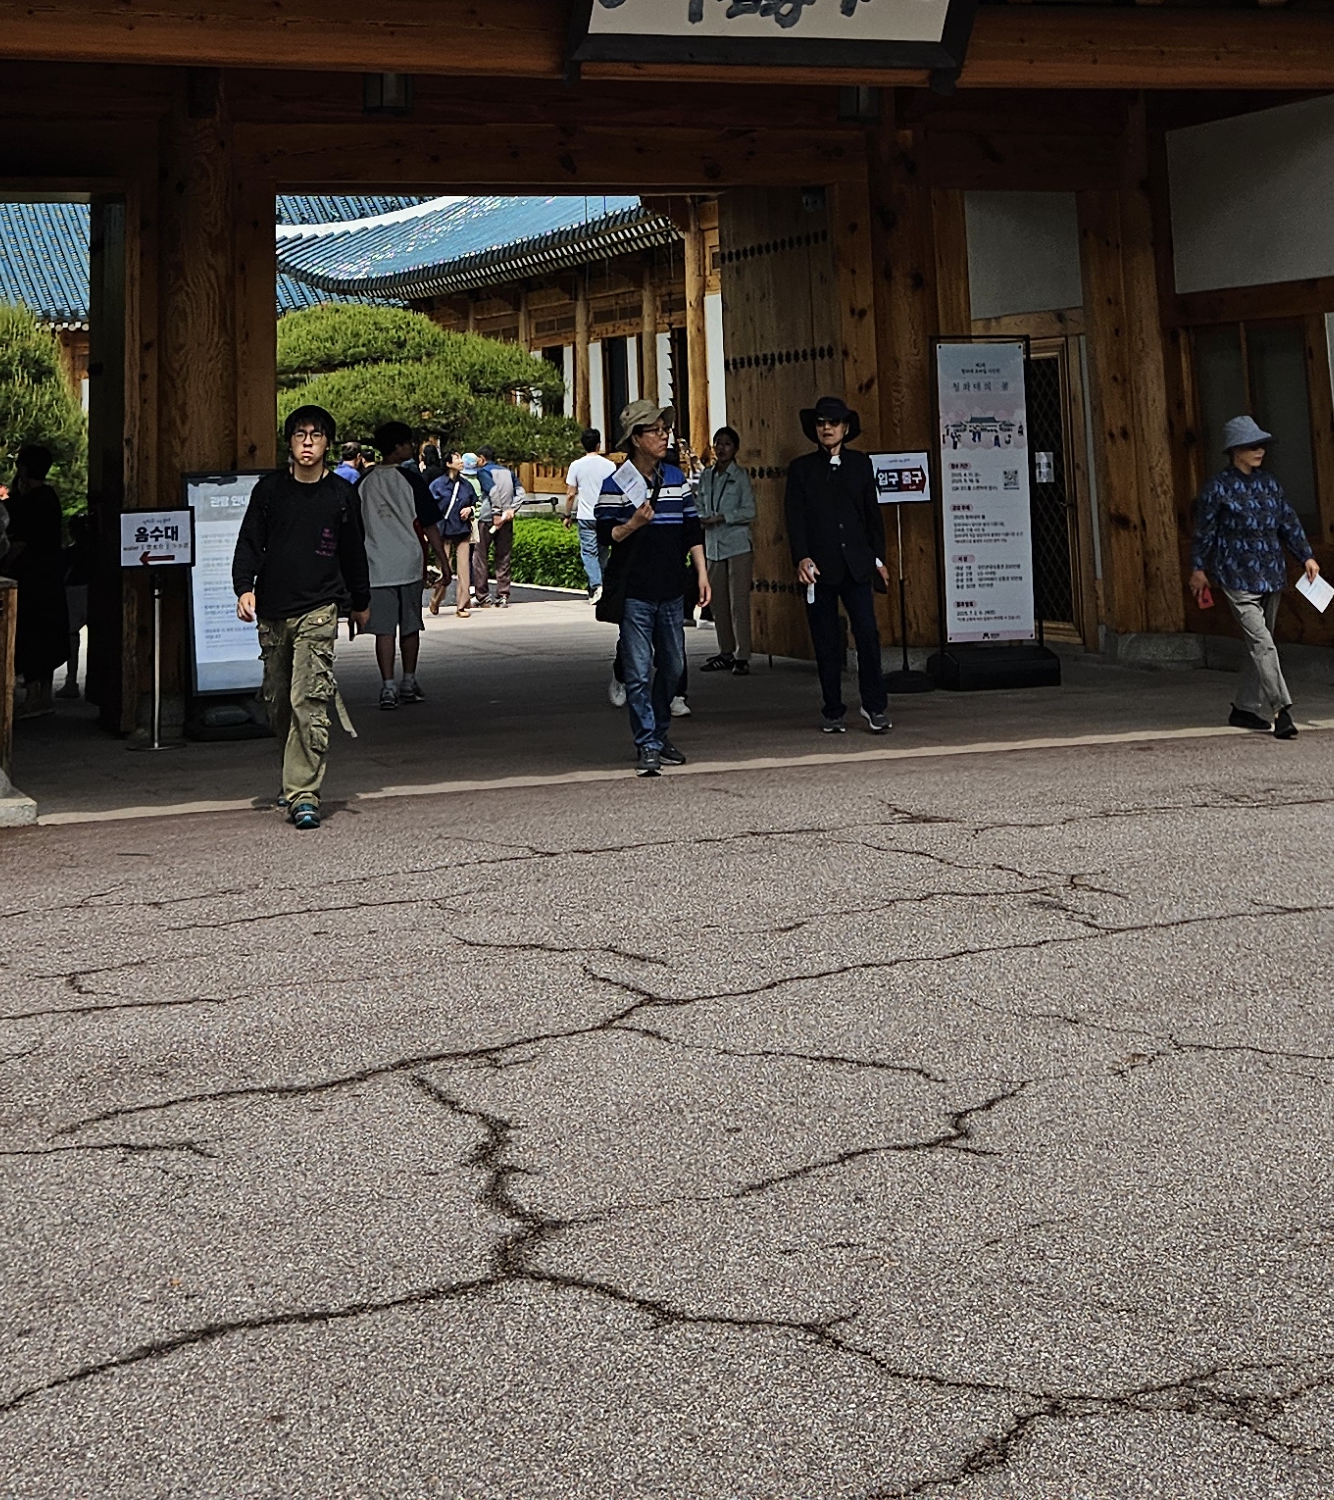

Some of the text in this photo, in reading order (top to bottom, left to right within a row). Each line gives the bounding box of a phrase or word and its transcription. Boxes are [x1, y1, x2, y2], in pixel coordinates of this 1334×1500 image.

[877, 471, 923, 486] 입구 출구
[134, 525, 179, 543] 음수대
